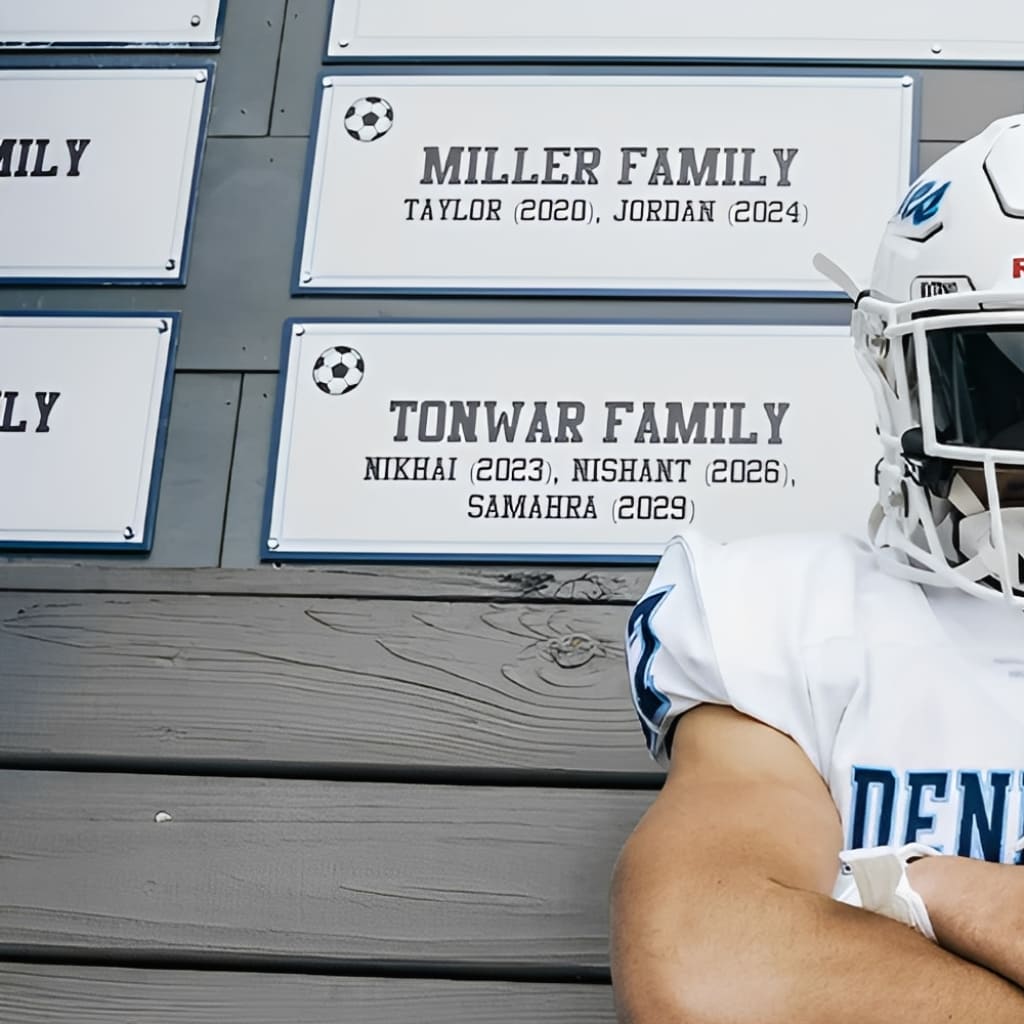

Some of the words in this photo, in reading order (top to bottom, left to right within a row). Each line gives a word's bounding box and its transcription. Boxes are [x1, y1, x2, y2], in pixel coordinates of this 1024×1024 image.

[419, 146, 601, 186] MILLER
[617, 147, 799, 187] FAMILY
[404, 198, 502, 222] TAYLOR
[513, 199, 601, 226] (2020),
[613, 199, 716, 223] JORDAN
[727, 200, 809, 228] (2024)
[0, 390, 61, 433] LY
[389, 400, 585, 443] TONWAR
[602, 401, 790, 445] FAMILY
[363, 456, 458, 482] NIKHAI
[469, 457, 559, 485] (2023),
[571, 458, 692, 483] NISHANT
[705, 459, 796, 488] (2026),
[467, 494, 598, 520] SAMAHRA
[611, 495, 696, 524] (2029)
